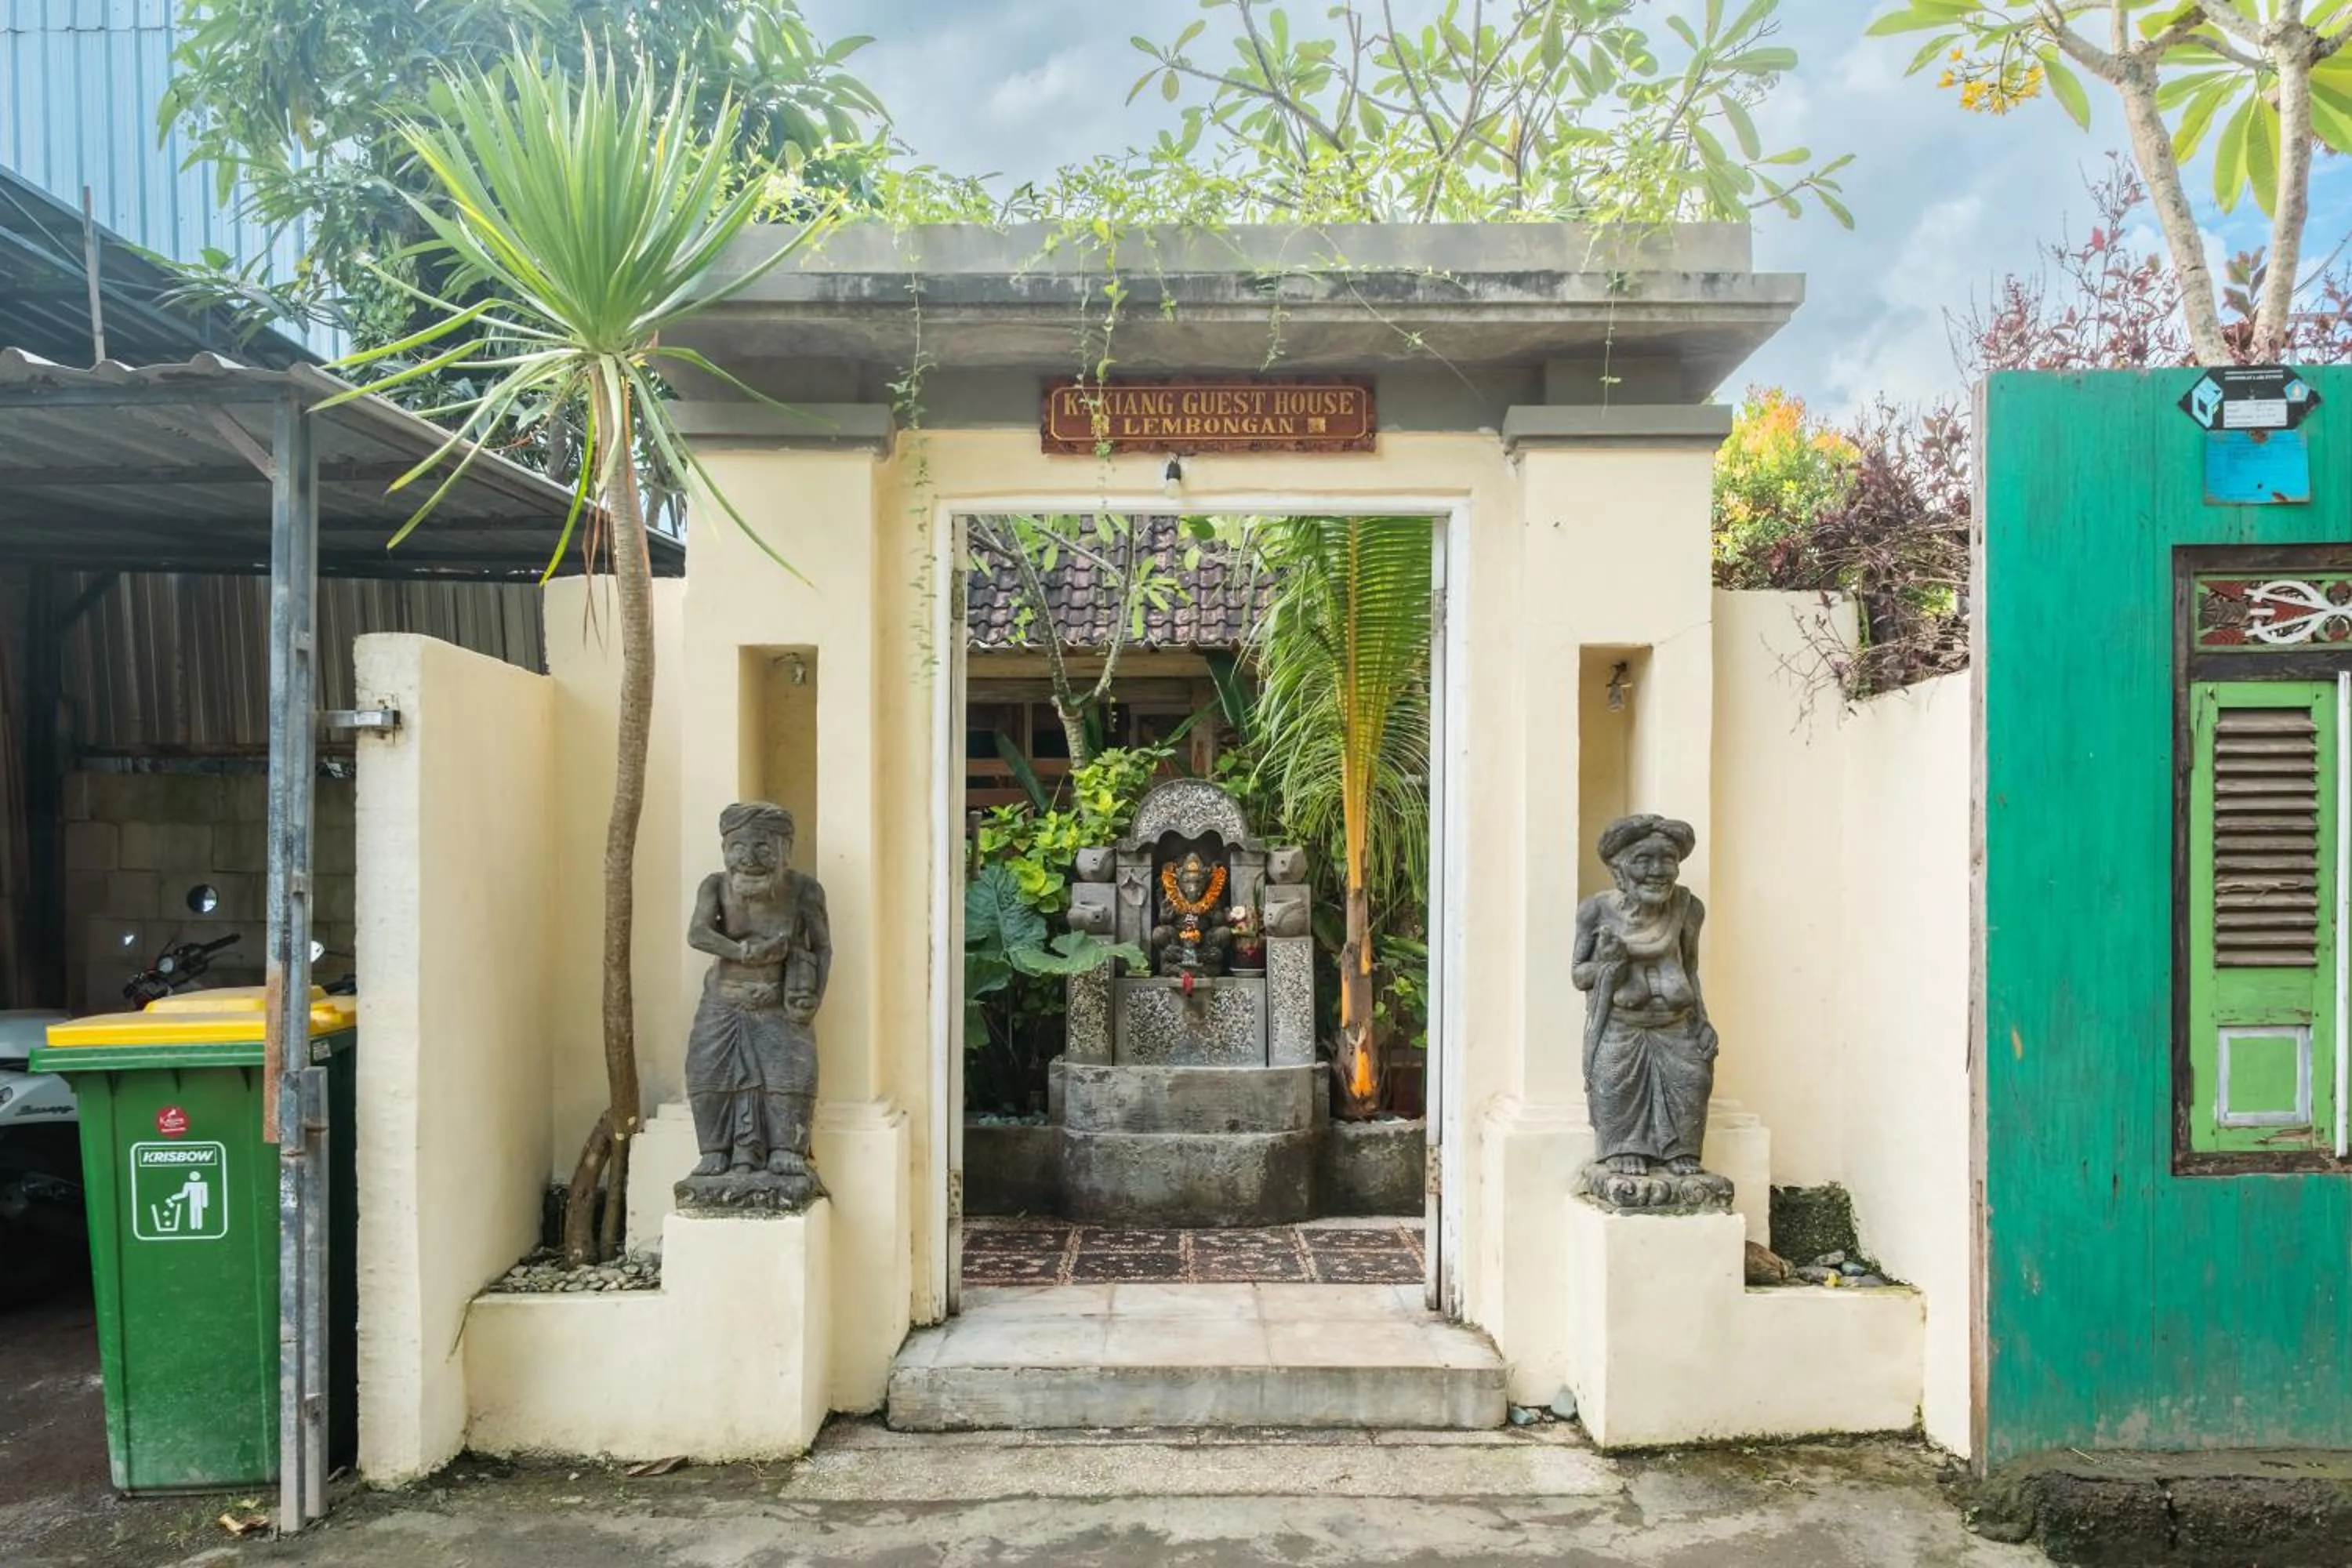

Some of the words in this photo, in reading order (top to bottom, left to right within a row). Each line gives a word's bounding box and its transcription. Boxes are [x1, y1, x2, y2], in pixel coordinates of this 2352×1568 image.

[1181, 392, 1266, 415] GUEST
[1274, 392, 1354, 415] HOUSE
[1123, 417, 1294, 434] LEMBONGAN
[143, 1150, 214, 1163] KRISBOW
